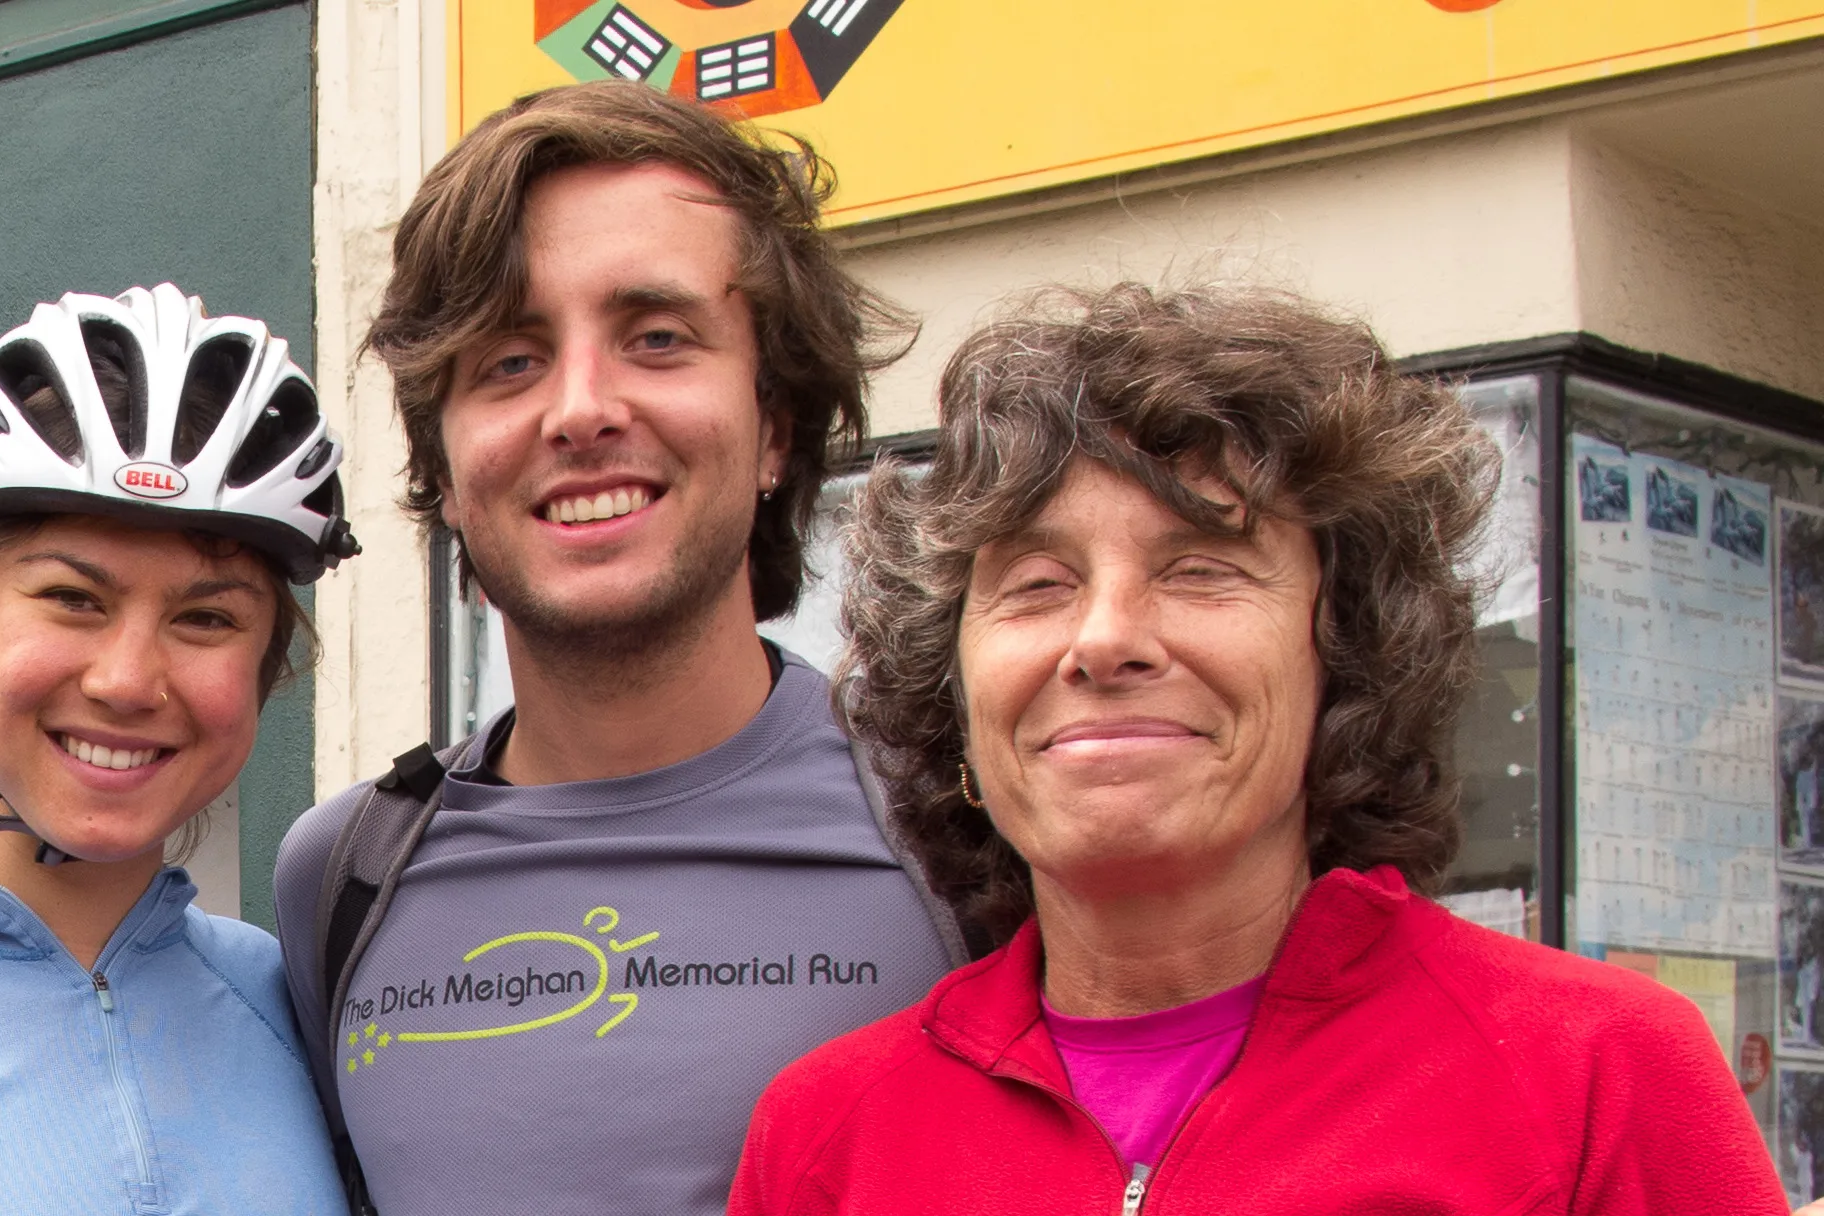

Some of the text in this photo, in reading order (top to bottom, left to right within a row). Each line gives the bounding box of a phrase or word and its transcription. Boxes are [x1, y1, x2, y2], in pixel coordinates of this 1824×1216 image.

[125, 470, 176, 491] BELL
[342, 953, 877, 1030] The Dick Meighan Memorial Run
